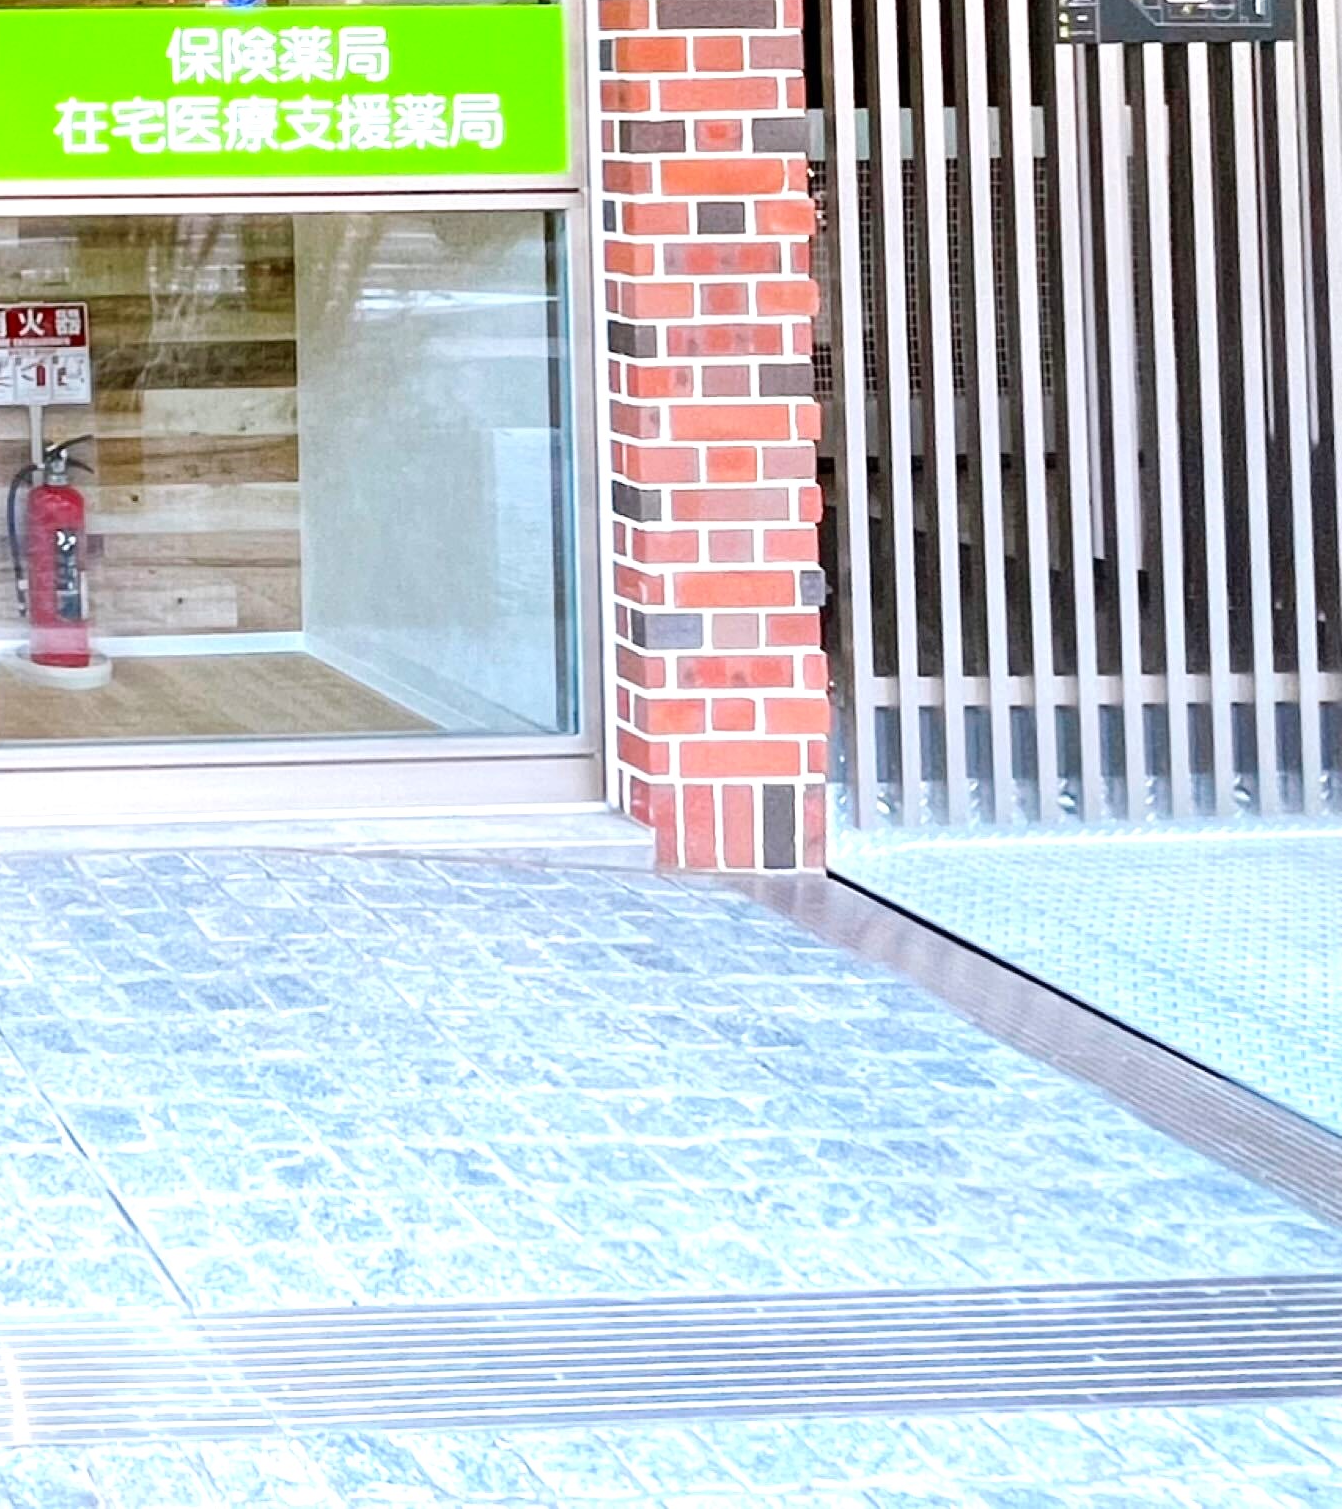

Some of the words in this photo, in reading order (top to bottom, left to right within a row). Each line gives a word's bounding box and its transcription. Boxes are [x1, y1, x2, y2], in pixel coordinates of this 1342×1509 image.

[166, 26, 390, 84] 保険薬局
[53, 93, 505, 154] 在宅医療支援薬局
